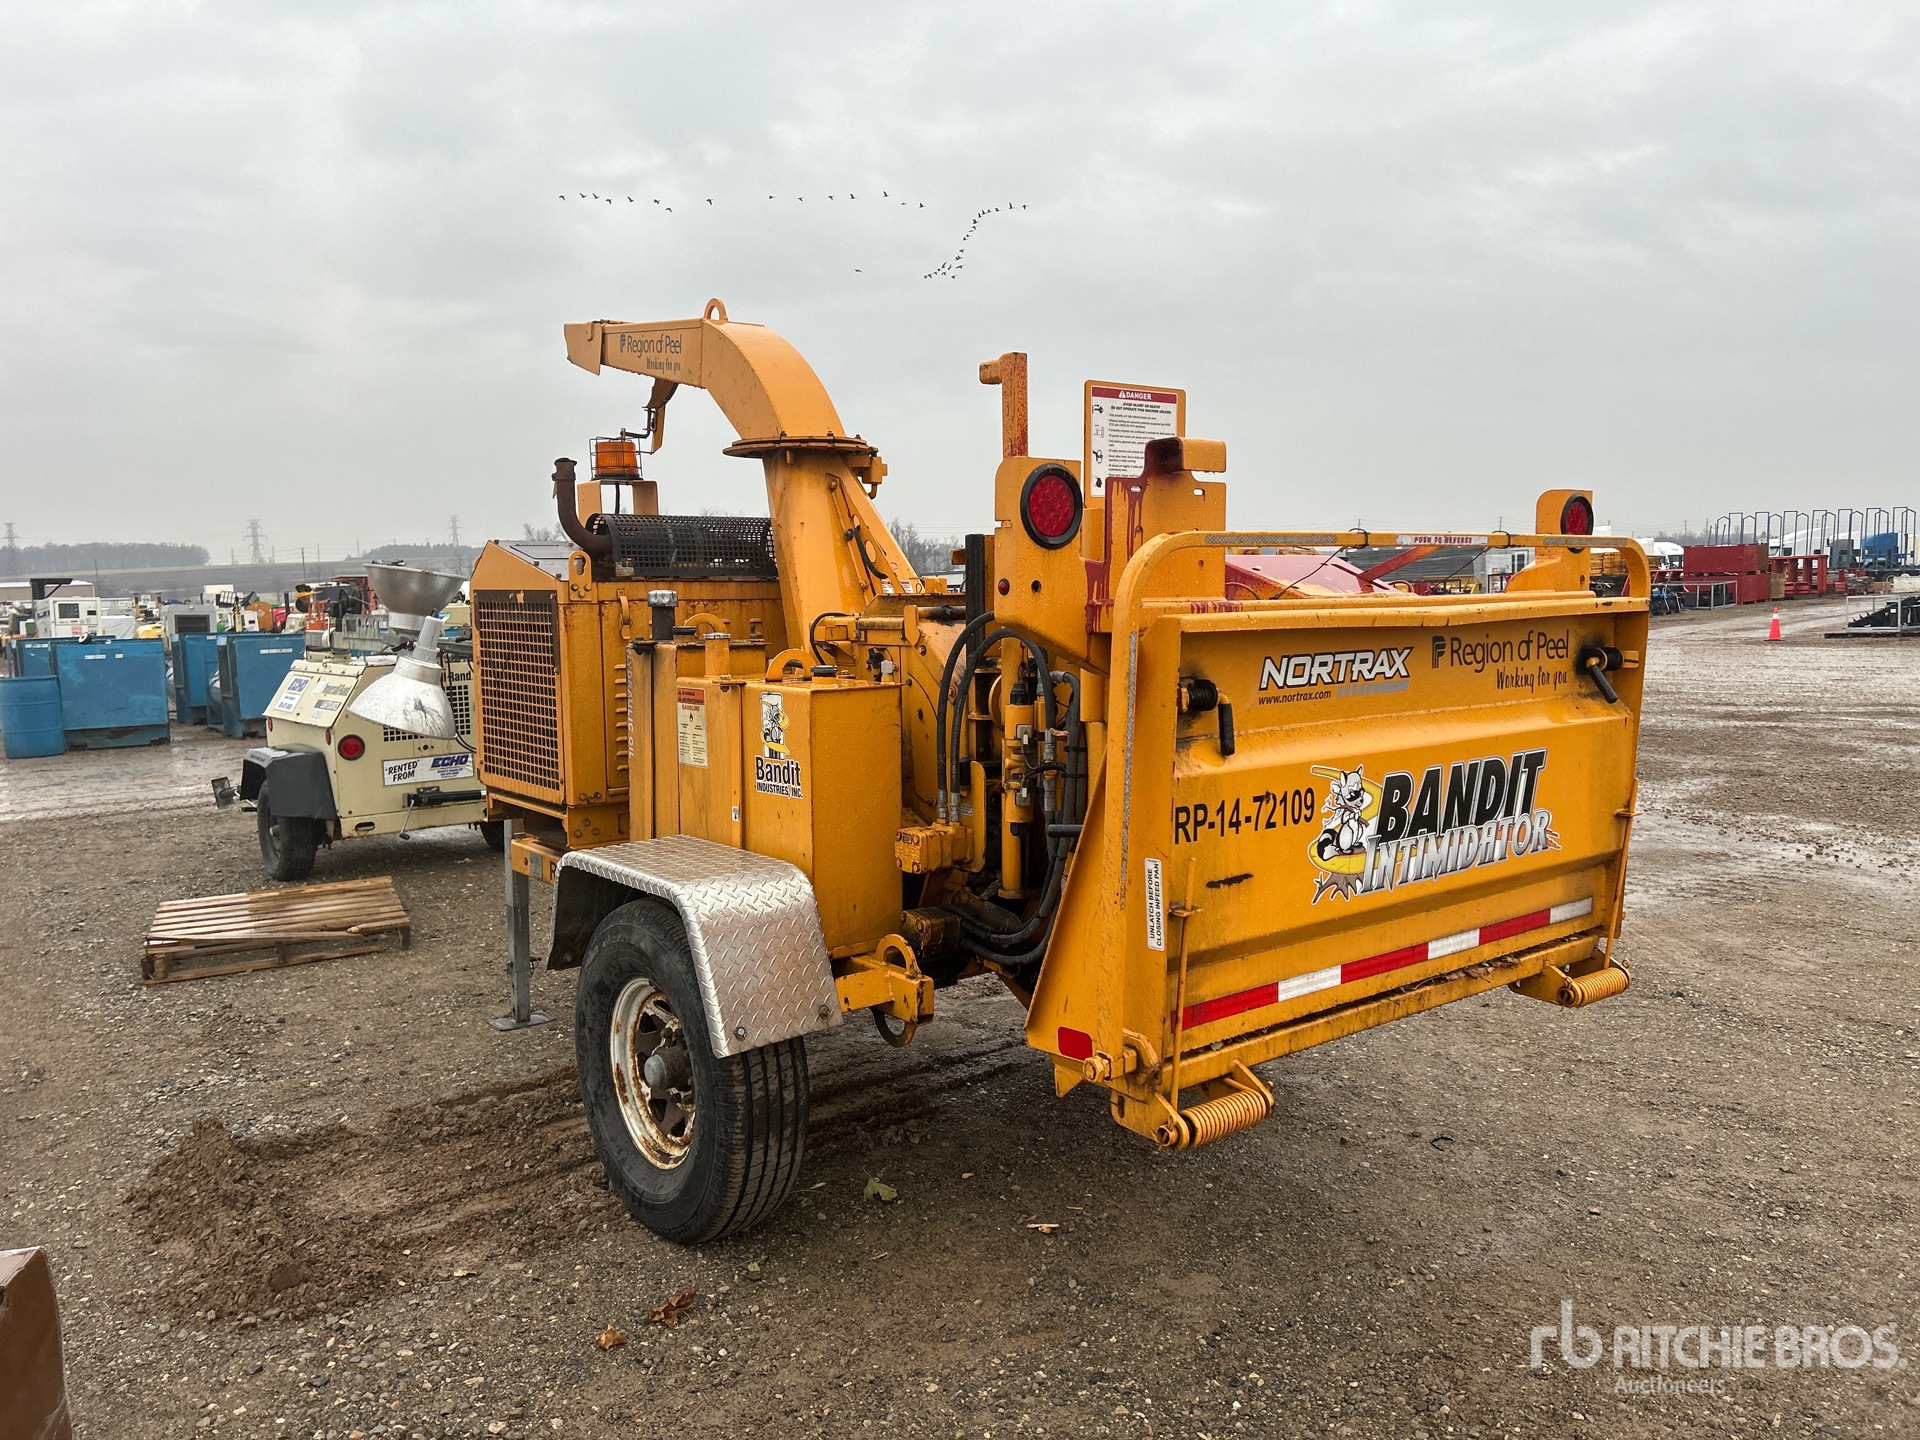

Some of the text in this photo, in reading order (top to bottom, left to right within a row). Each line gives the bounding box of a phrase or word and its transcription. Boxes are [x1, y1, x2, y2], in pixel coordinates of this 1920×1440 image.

[627, 334, 682, 358] Region of Peel
[1126, 391, 1152, 400] DANGER
[1414, 536, 1473, 544] PUSH TO REVERSE
[1450, 629, 1569, 673] Region of Peel
[1258, 646, 1415, 691] NORTRAX
[1496, 665, 1567, 693] Working for you
[1258, 690, 1331, 705] www.nortrax.com
[431, 754, 469, 768] ECHO
[756, 757, 801, 786] Bandit
[393, 770, 415, 782] FROM
[791, 788, 803, 798] INC.
[1376, 748, 1548, 841] BANDIT
[1174, 787, 1315, 845] RP-14-72109
[1358, 809, 1552, 894] INTIMIDATOR
